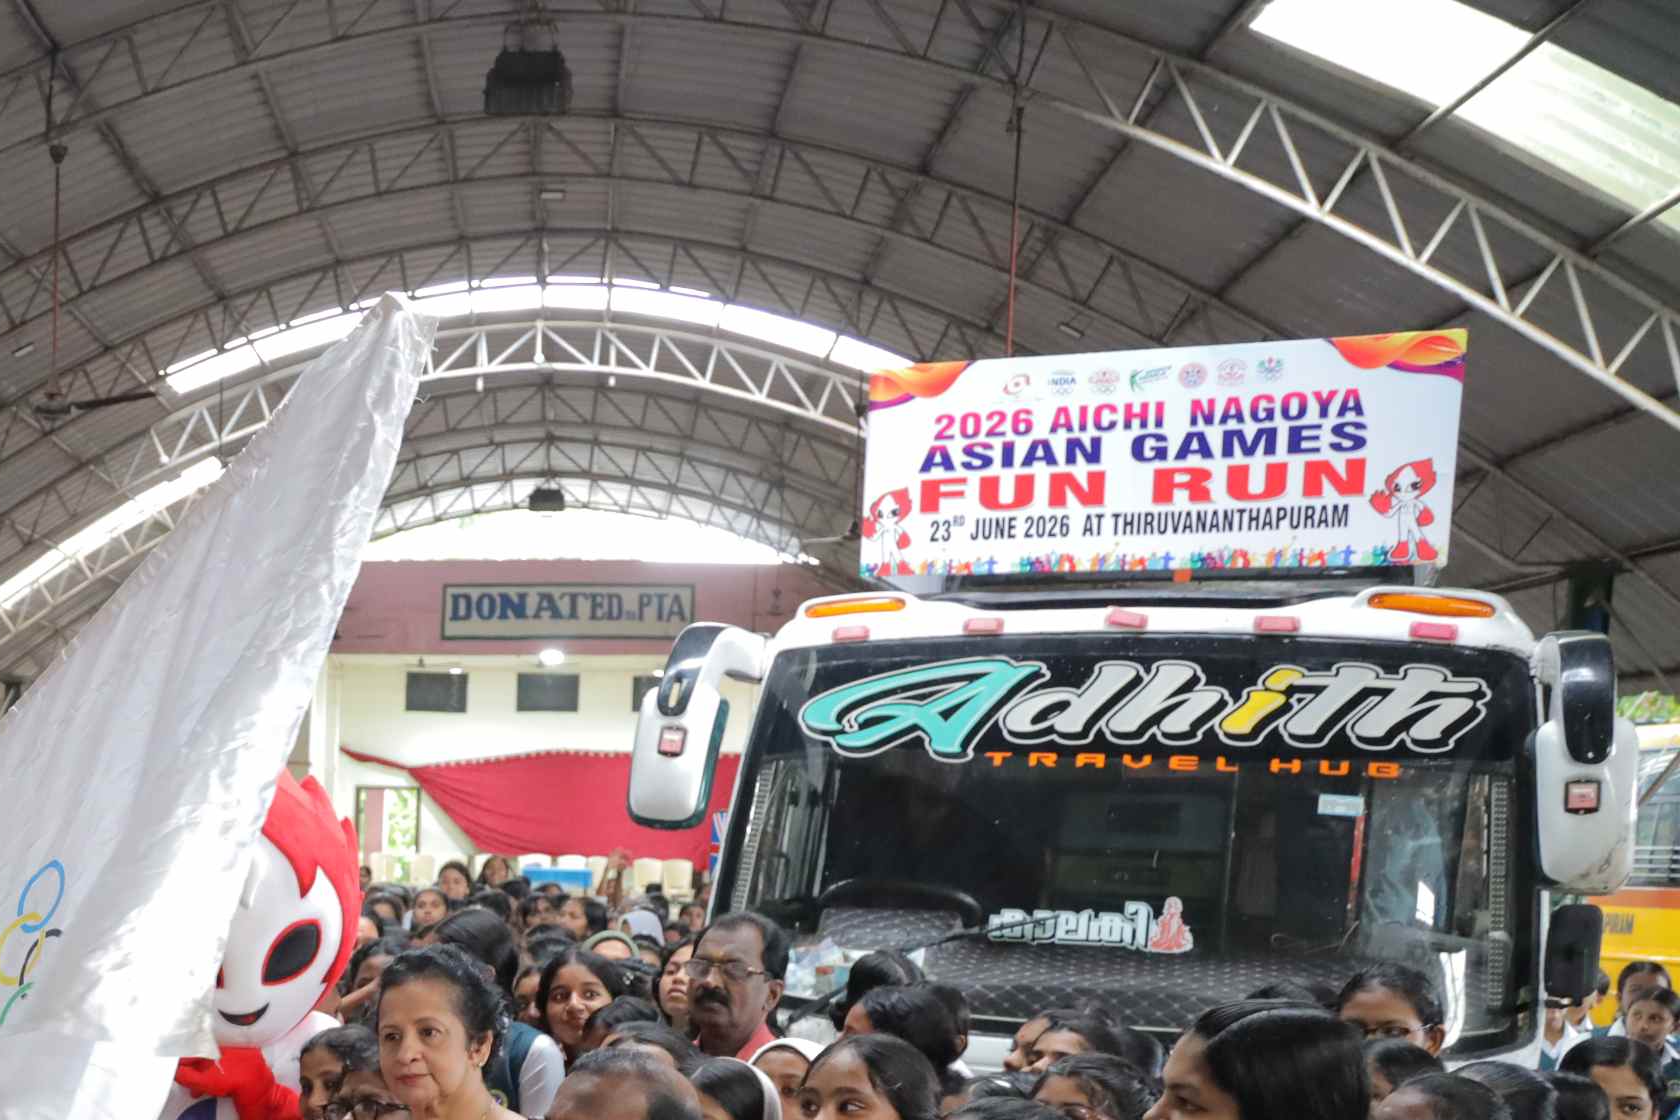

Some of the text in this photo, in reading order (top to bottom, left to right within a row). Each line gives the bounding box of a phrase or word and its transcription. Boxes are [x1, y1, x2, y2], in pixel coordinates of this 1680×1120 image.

[933, 387, 1366, 441] 2026 AICHI NAGOYA
[919, 420, 1368, 474] ASIAN GAMES
[919, 457, 1368, 514] FUN RUN
[929, 503, 1350, 543] 23RD JUNE 2026 AT THIRUVANANTHAPURAM
[448, 591, 623, 622] DONATED
[638, 592, 688, 622] PTA
[984, 750, 1401, 778] TRAVEL HUB
